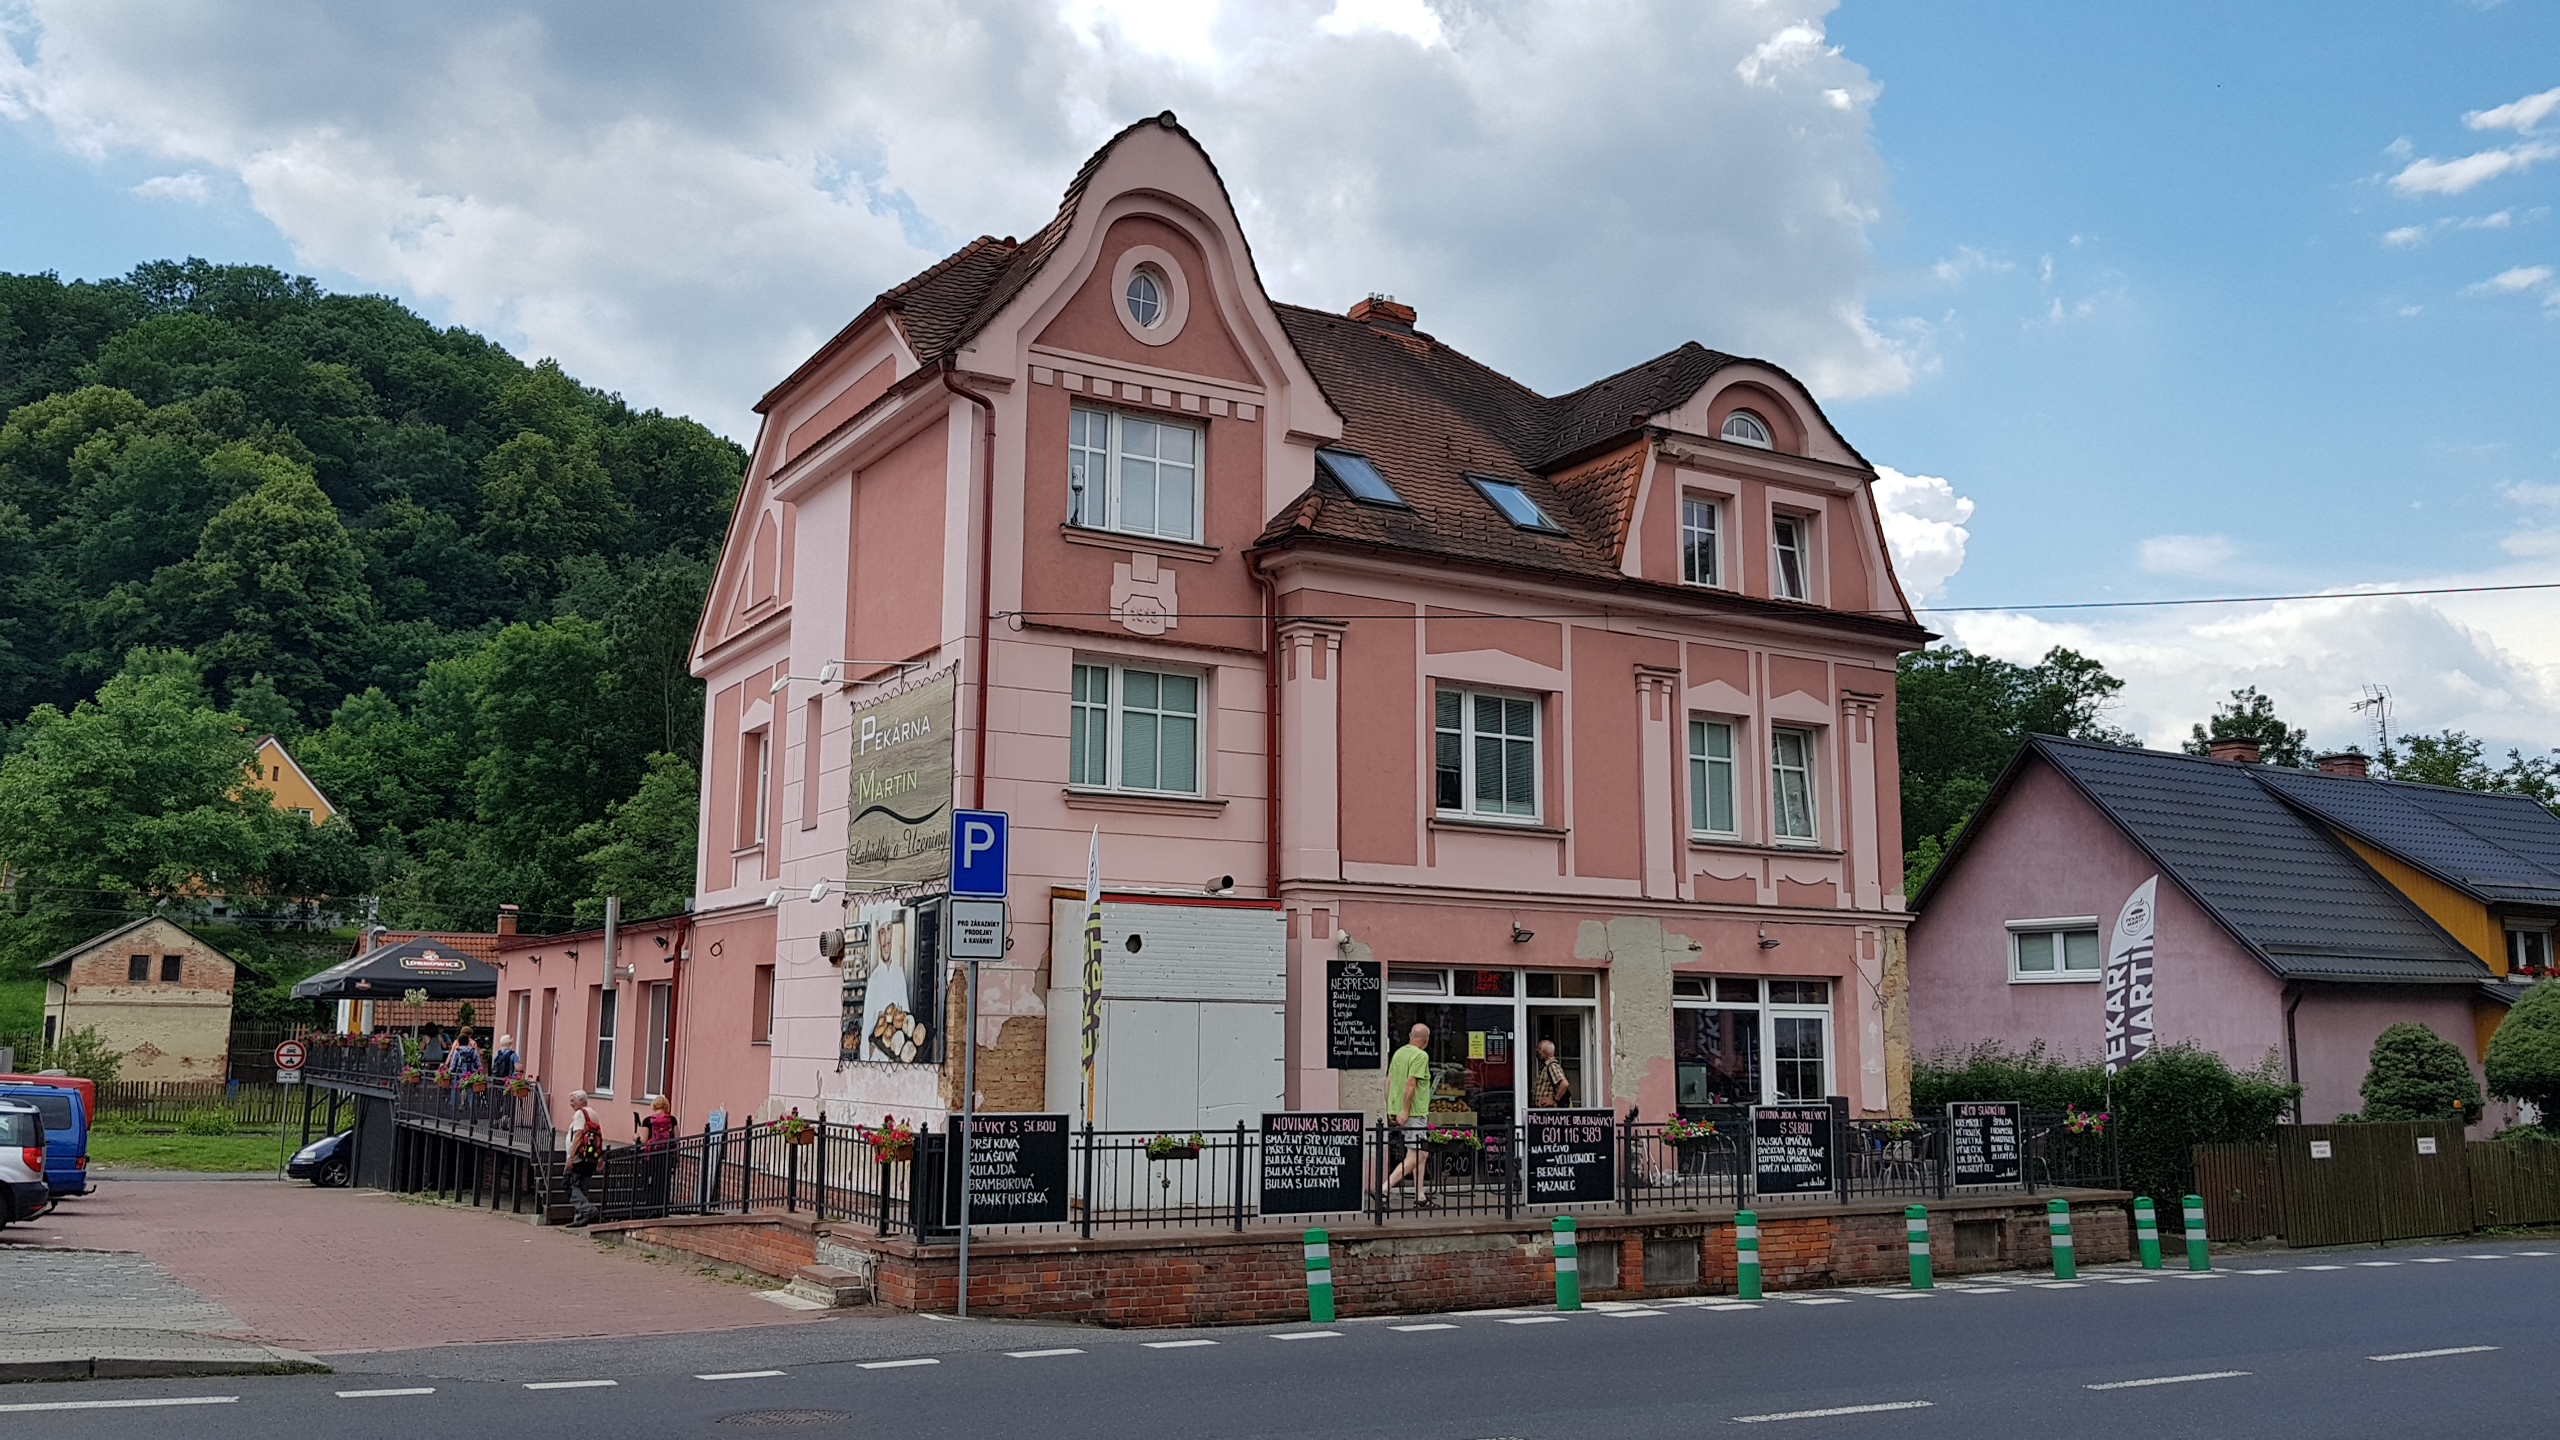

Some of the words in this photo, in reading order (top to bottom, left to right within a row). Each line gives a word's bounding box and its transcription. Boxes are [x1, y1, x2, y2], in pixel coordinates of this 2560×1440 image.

[860, 715, 931, 756] PEKÁRNA
[858, 770, 918, 806] MARTIN
[893, 843, 899, 857] a
[903, 827, 949, 856] Uzeniny
[963, 821, 996, 869] P
[970, 919, 1001, 928] ZÁKAZNÍKY
[968, 936, 993, 945] KAVÁRNY
[1331, 977, 1380, 991] NESPRESSO
[1010, 1120, 1019, 1133] S
[1023, 1120, 1057, 1133] SEBOU
[1272, 1116, 1319, 1132] NOVINKA
[1320, 1116, 1329, 1132] S
[1330, 1117, 1360, 1132] SEBOU
[1572, 1113, 1614, 1127] OBJEDNÁVKY
[1542, 1127, 1561, 1143] 601
[1564, 1127, 1579, 1143] 116
[1582, 1126, 1601, 1143] 989
[1780, 1121, 1787, 1134] S
[1788, 1121, 1813, 1134] SEBOU
[1264, 1155, 1294, 1165] BULKA
[1264, 1165, 1294, 1177] BULKA
[968, 1173, 1035, 1190] BRAMBOROVÁ
[1264, 1178, 1294, 1190] BULKA
